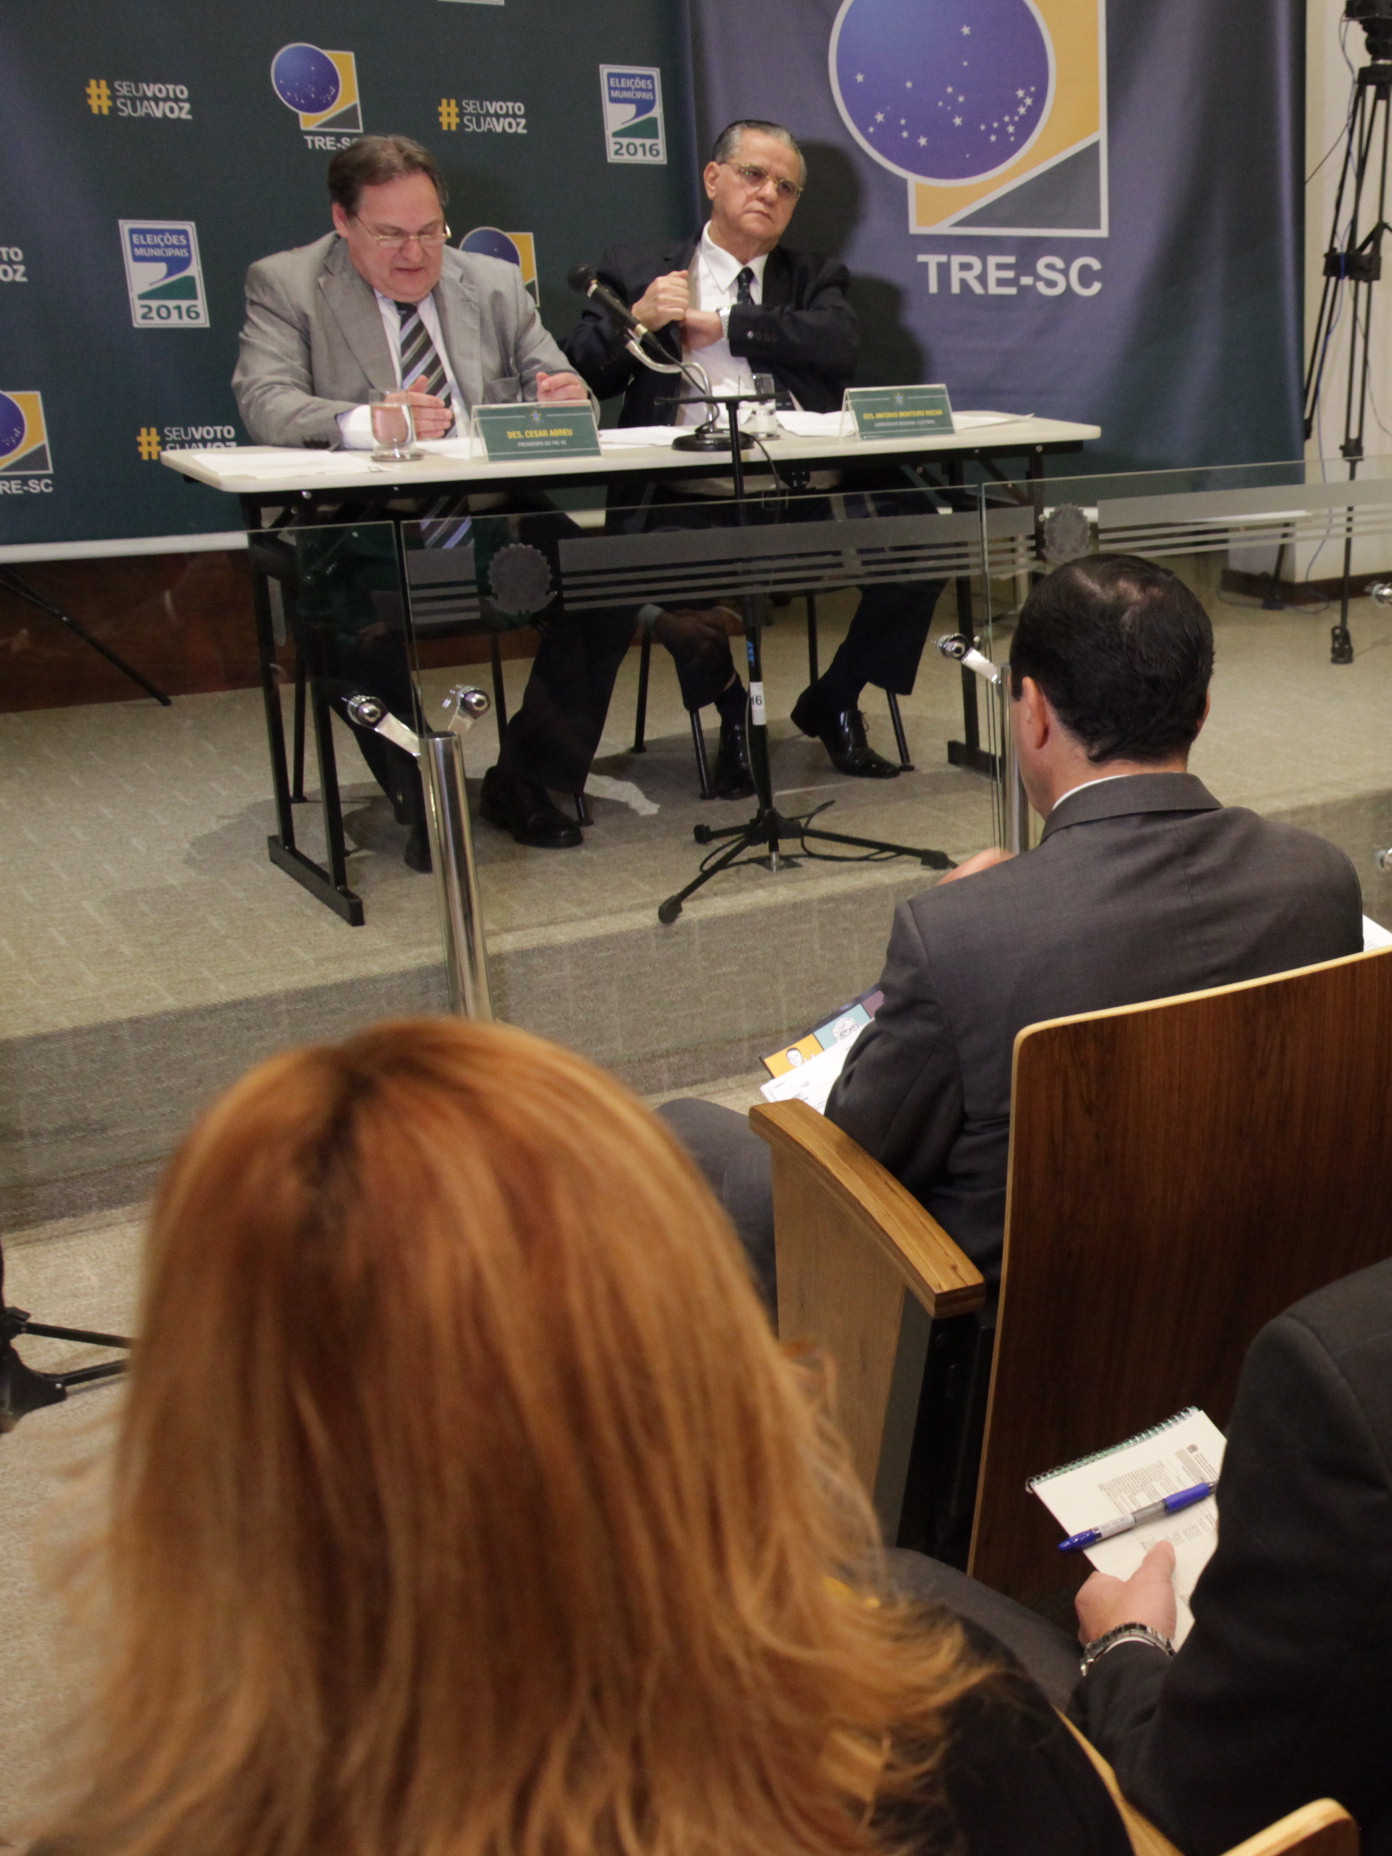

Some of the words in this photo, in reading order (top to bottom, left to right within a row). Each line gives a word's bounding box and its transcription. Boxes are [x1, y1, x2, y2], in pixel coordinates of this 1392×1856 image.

[114, 81, 189, 99] SEUVOTO
[609, 76, 653, 90] ELEIÇÕES
[610, 89, 654, 100] MUNICIPAIS
[116, 98, 193, 119] SUAVOZ
[462, 100, 525, 115] SEUVOTO
[463, 115, 528, 134] SUAVOZ
[613, 141, 660, 157] 2016
[132, 231, 187, 248] ELEIÇÕES
[134, 247, 189, 258] MUNICIPAIS
[916, 254, 1103, 297] TRE-SC
[139, 303, 200, 320] 2016
[164, 425, 235, 441] SEUVOTO
[524, 429, 548, 438] CESAR
[549, 428, 573, 437] ABREU
